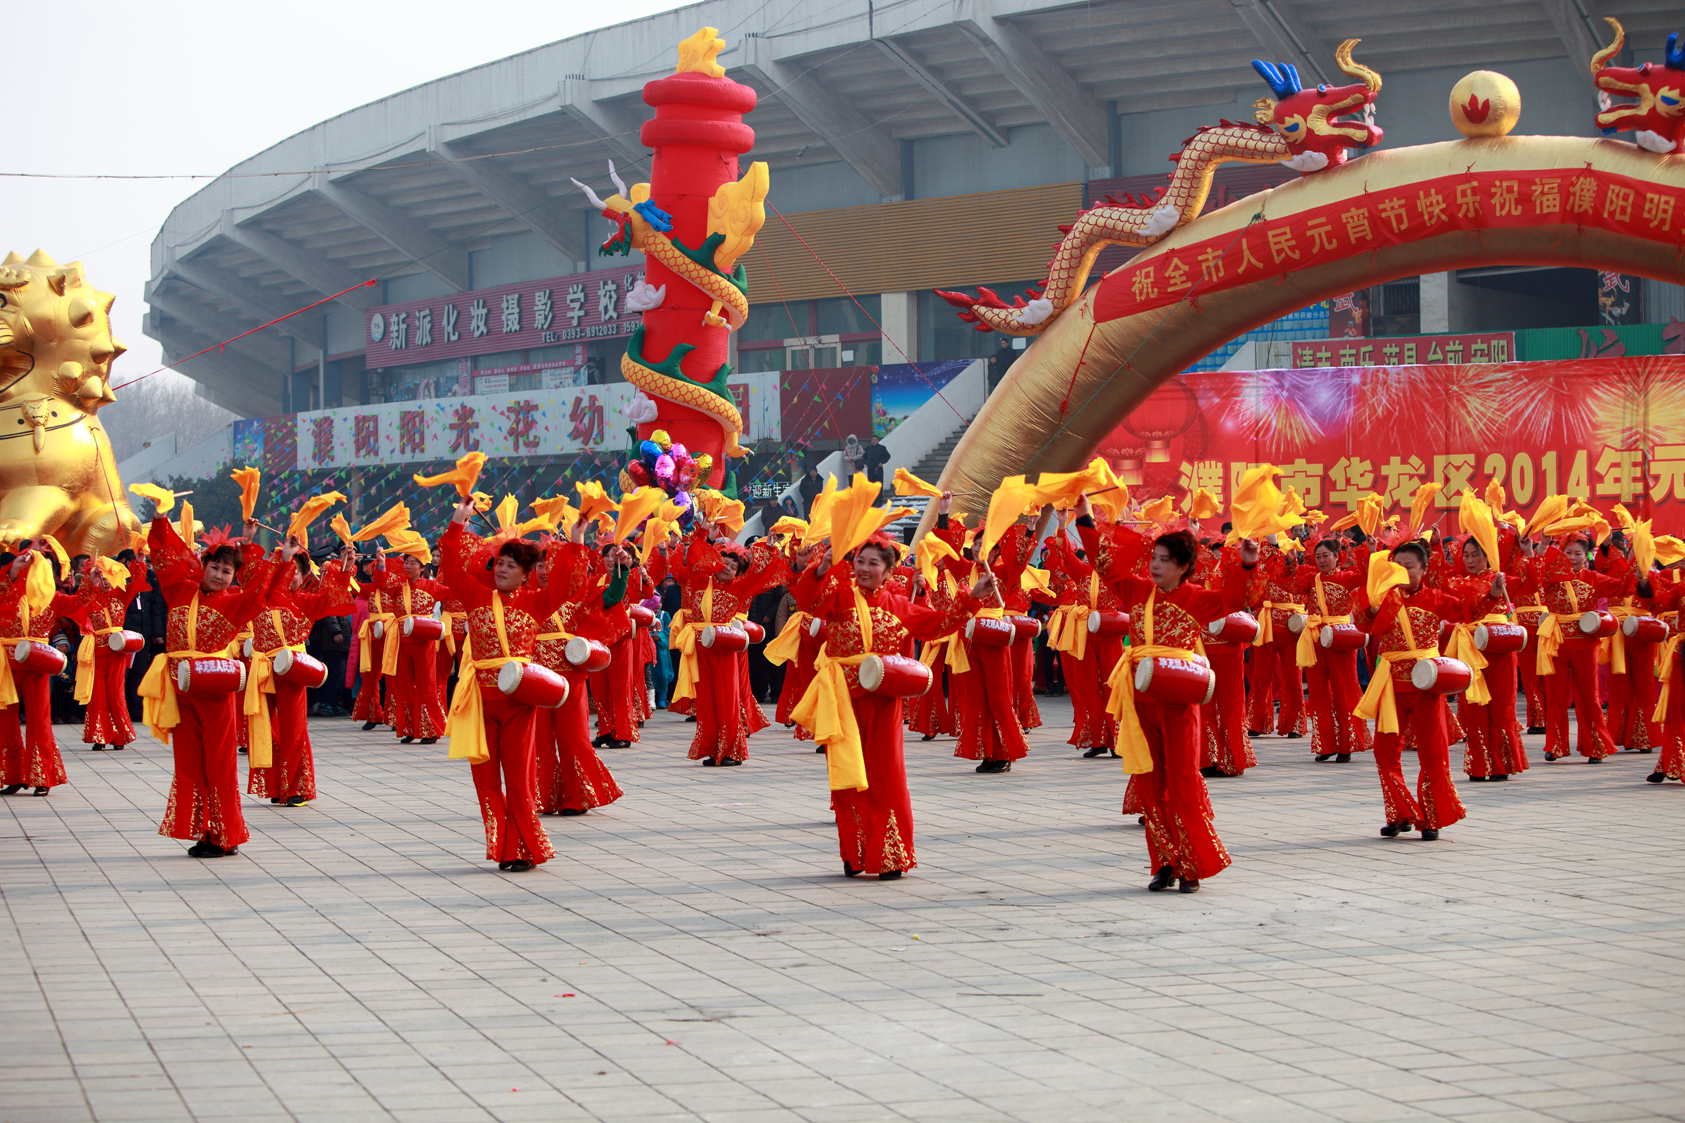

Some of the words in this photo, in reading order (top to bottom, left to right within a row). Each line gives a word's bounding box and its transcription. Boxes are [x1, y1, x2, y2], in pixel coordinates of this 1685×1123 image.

[1131, 176, 1685, 302] 祝全市人民元宵节快乐祝福濮阳明
[390, 279, 619, 350] 新派化妆摄影学校
